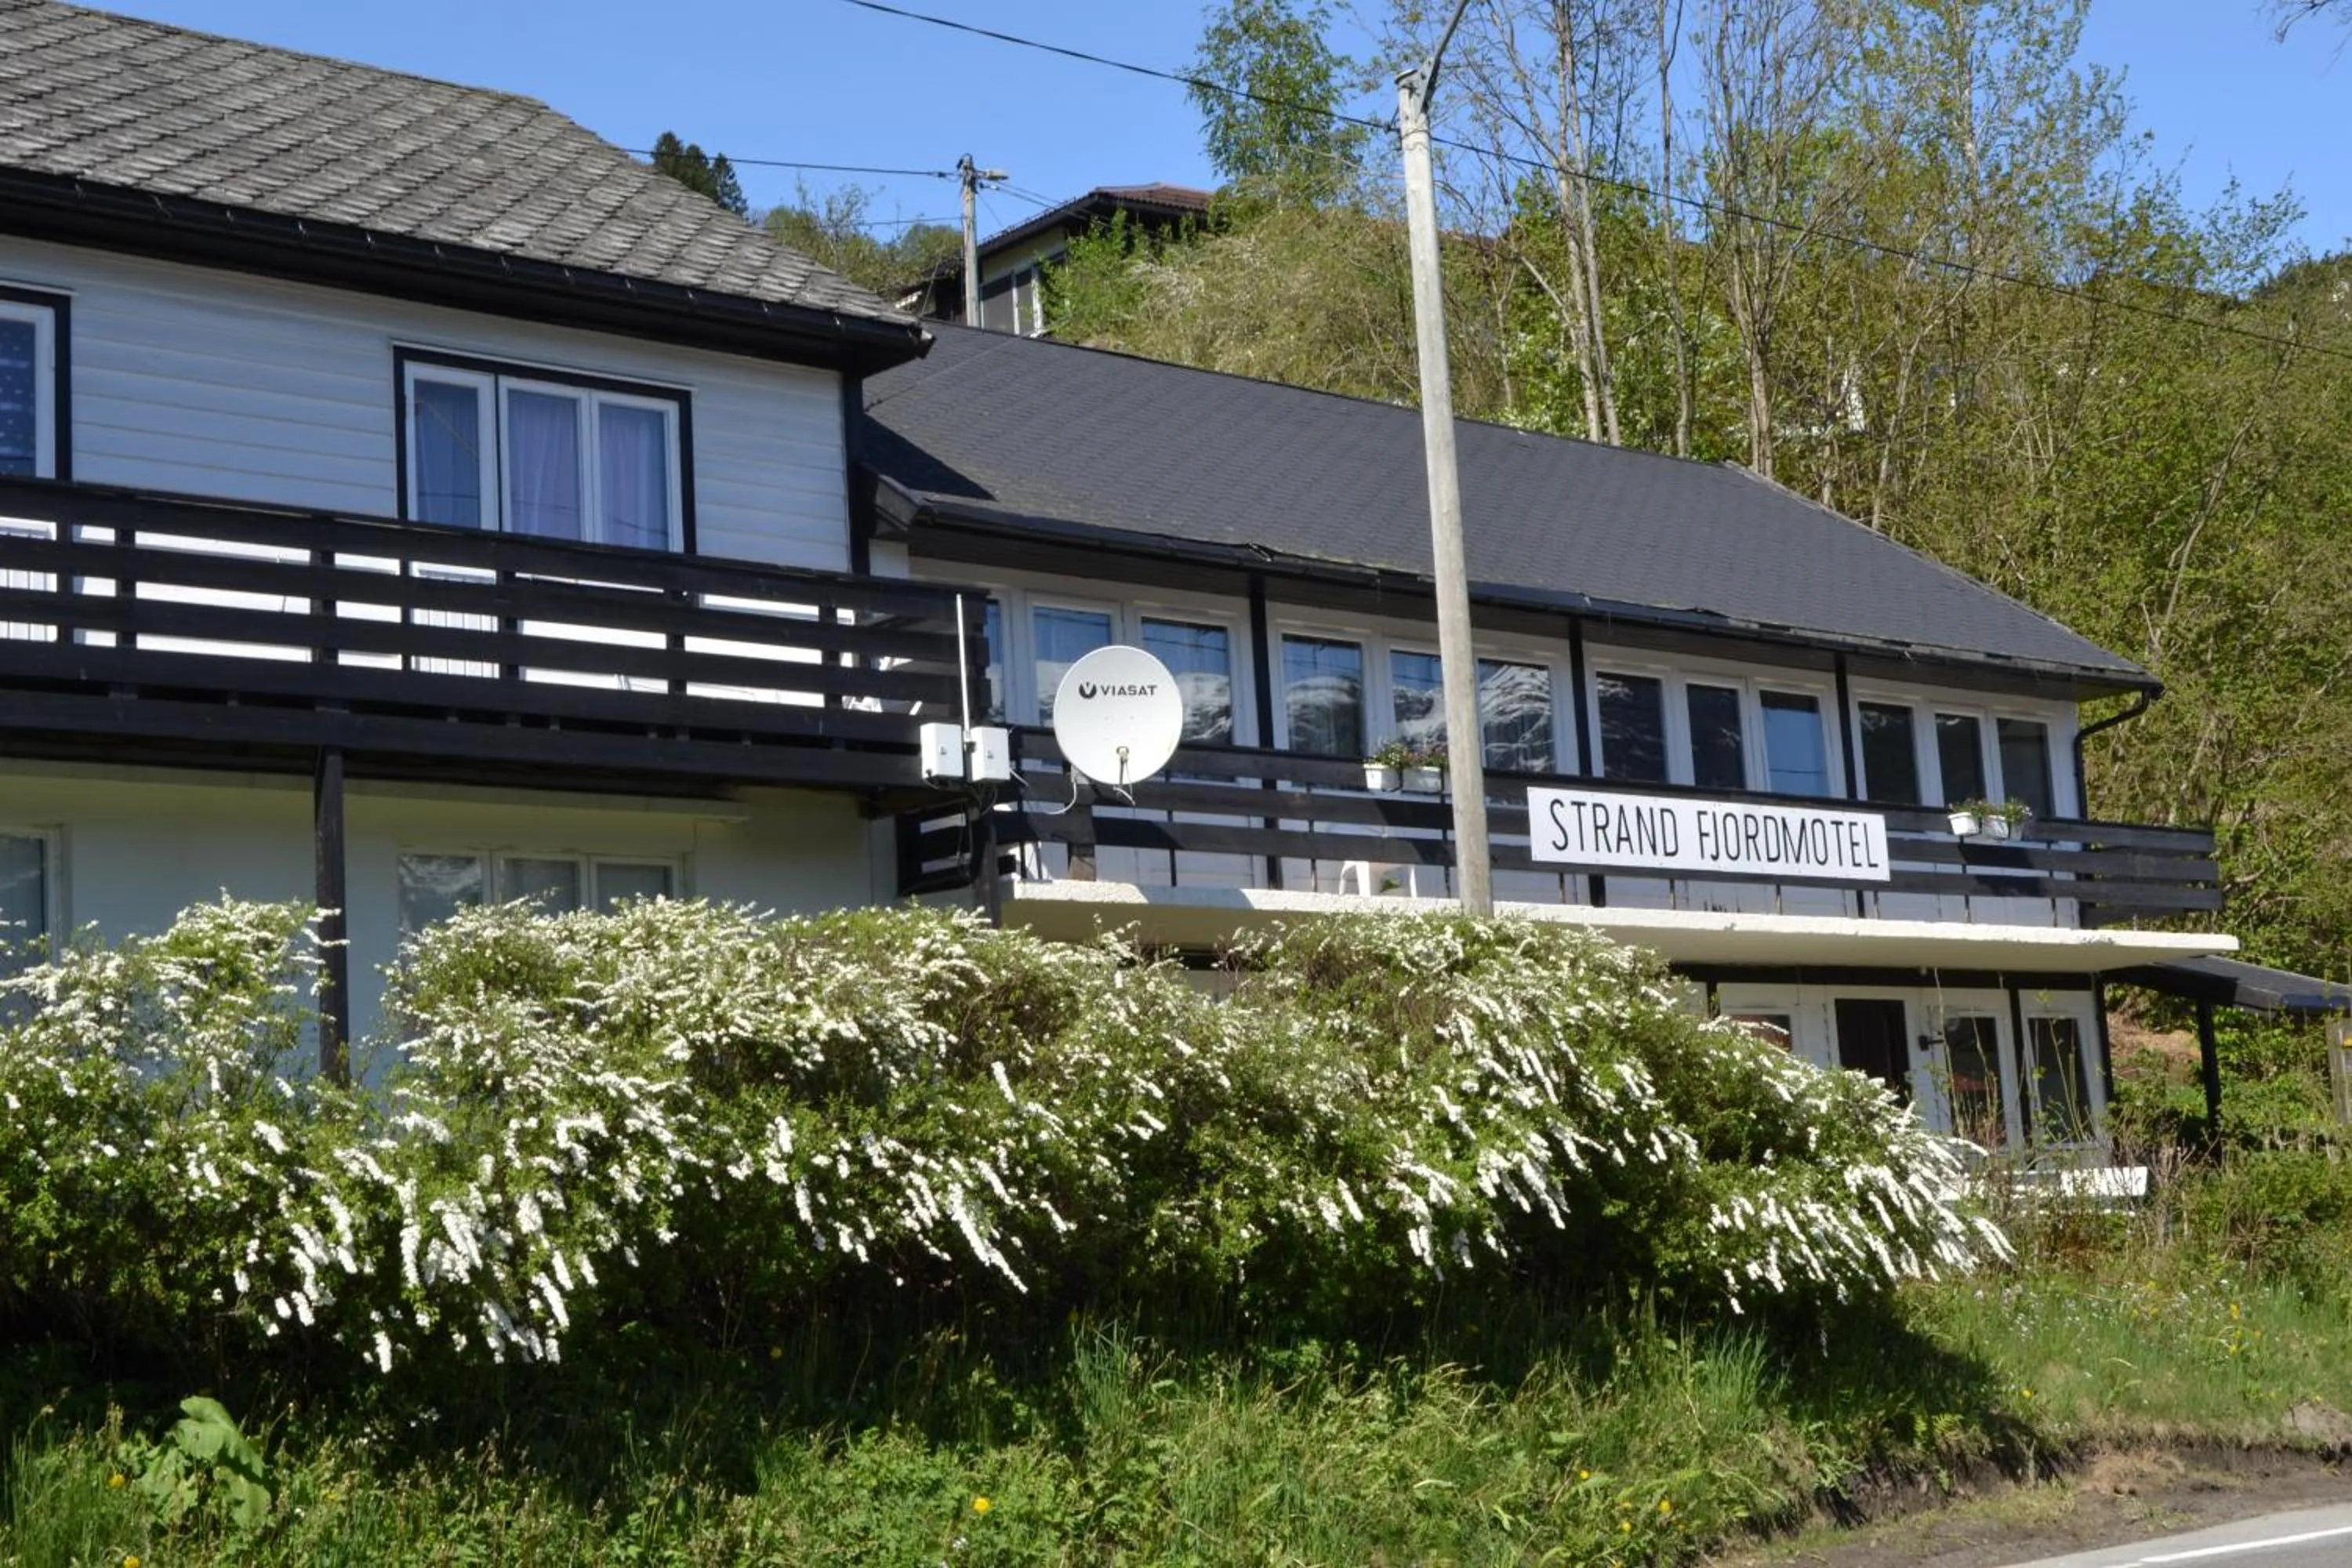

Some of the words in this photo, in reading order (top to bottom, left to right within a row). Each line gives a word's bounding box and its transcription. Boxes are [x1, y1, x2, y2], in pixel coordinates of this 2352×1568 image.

[1100, 684, 1157, 696] VIASAT
[1549, 798, 1679, 857] STRAND
[1697, 810, 1879, 868] FJORDMOTEL
